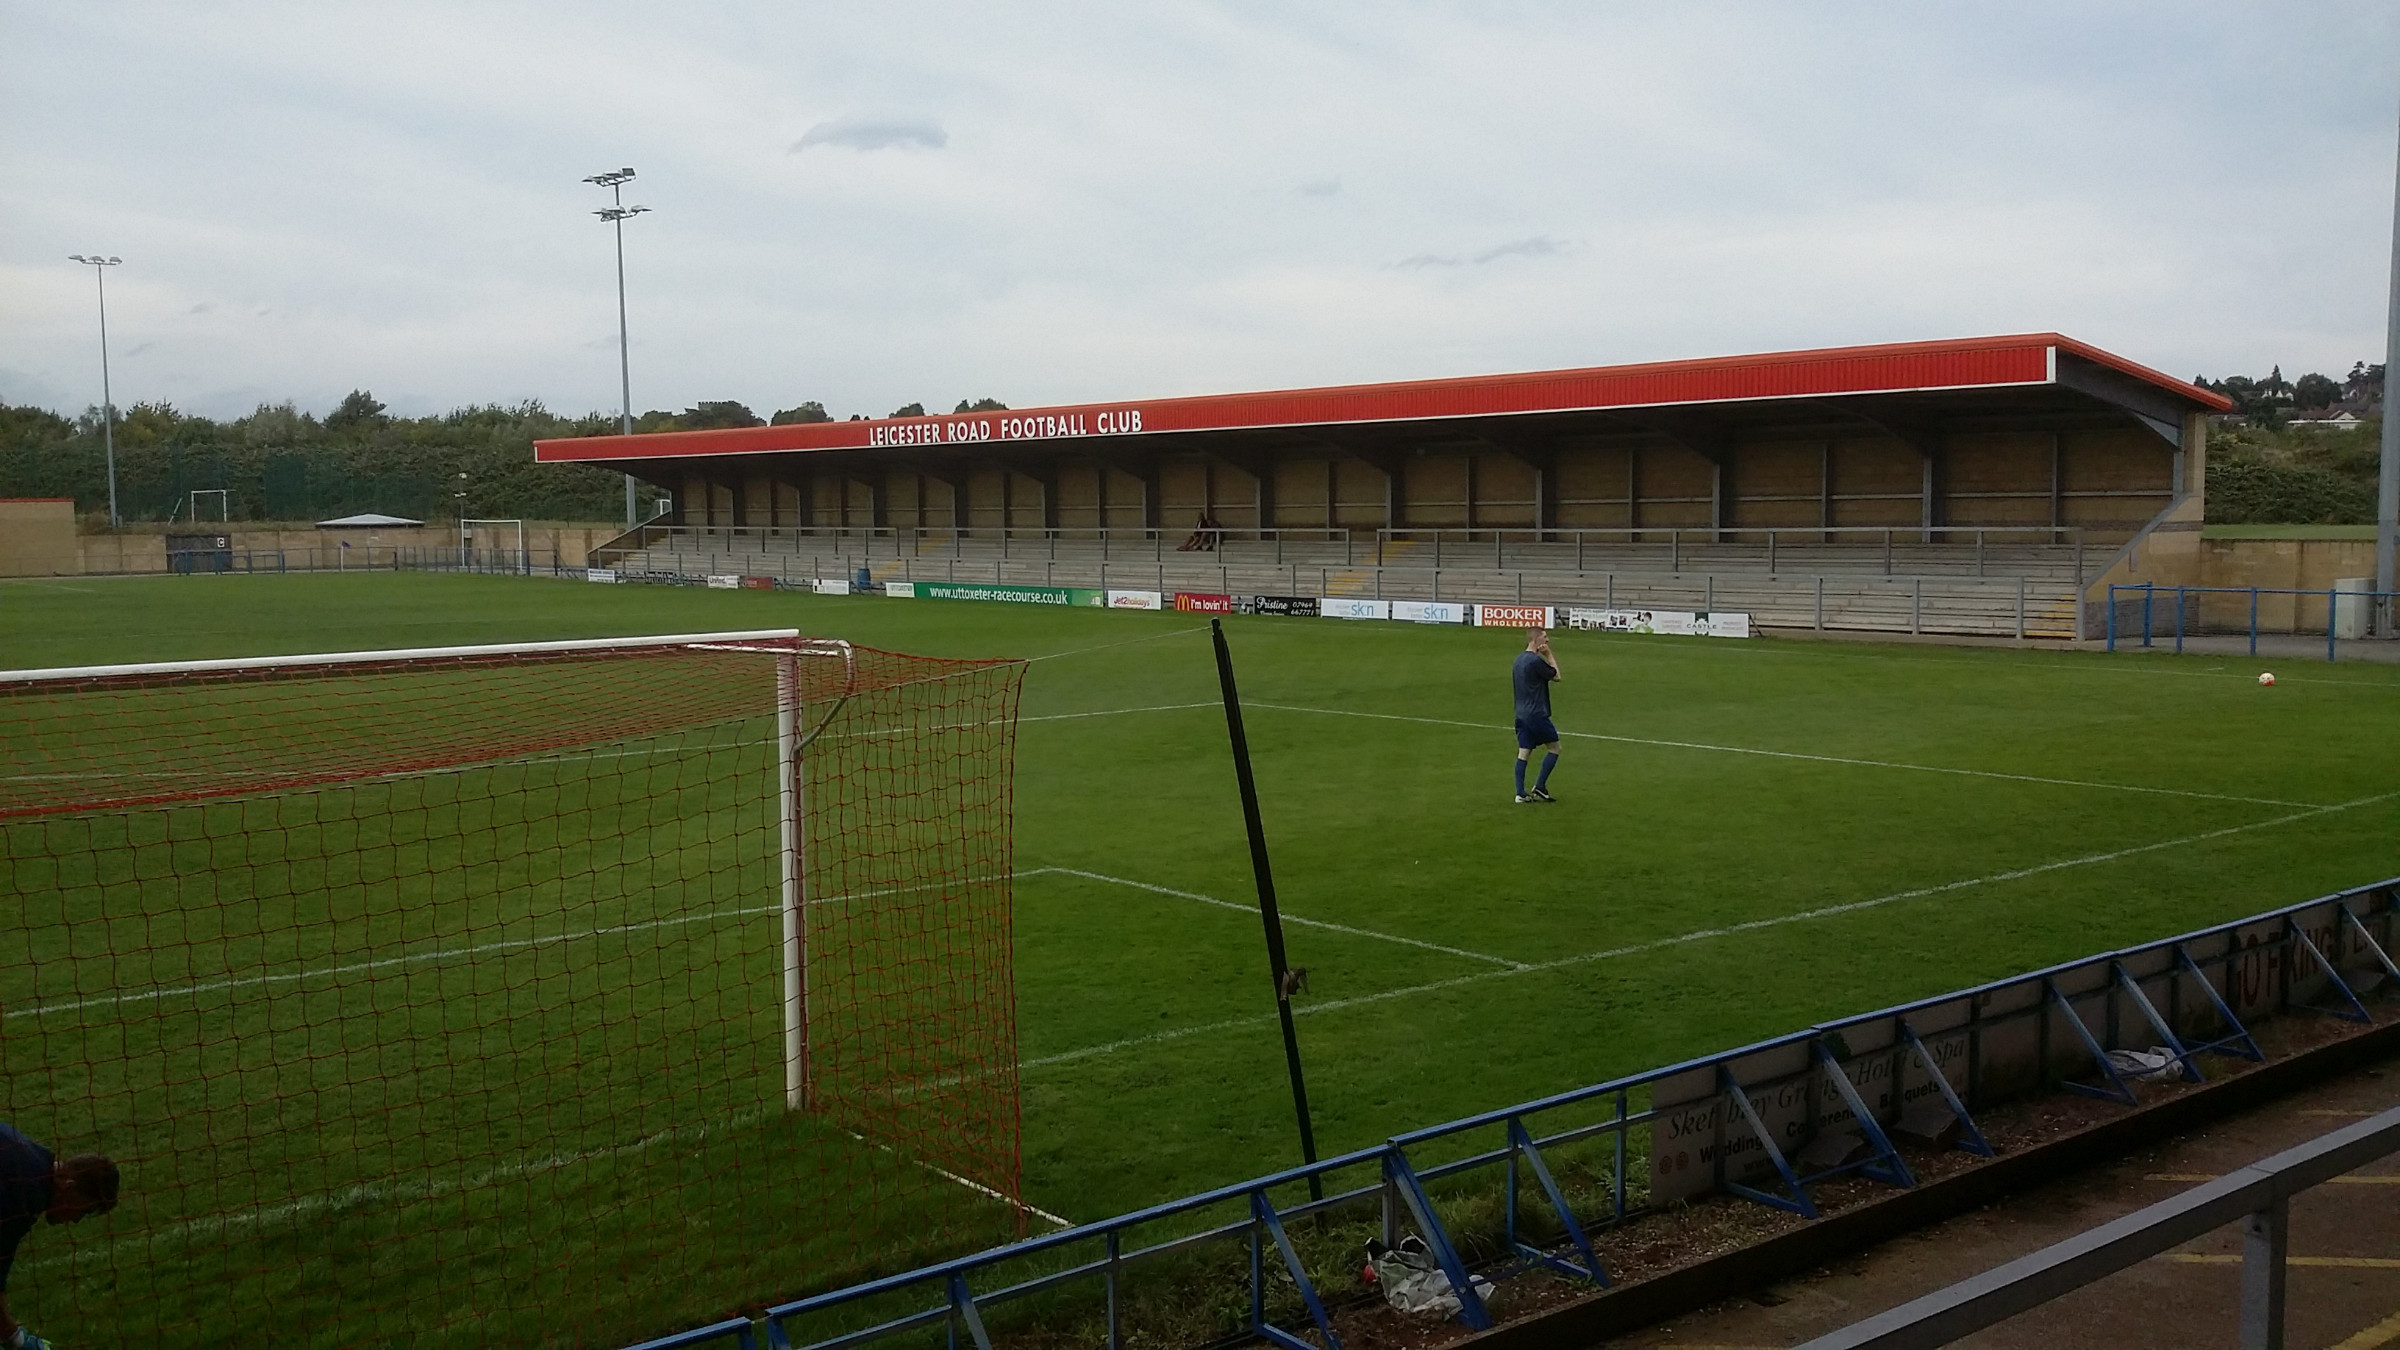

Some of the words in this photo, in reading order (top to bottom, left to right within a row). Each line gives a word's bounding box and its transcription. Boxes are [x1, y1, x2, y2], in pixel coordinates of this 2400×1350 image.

[869, 424, 941, 446] LEICESTER
[947, 420, 991, 442] ROAD
[1001, 414, 1087, 439] FOOTBALL
[1097, 410, 1142, 434] CLUB
[929, 585, 1068, 605] www.uttoxeter-racecourse.co.uk
[1222, 600, 1228, 611] it
[1484, 608, 1543, 620] BOOKER
